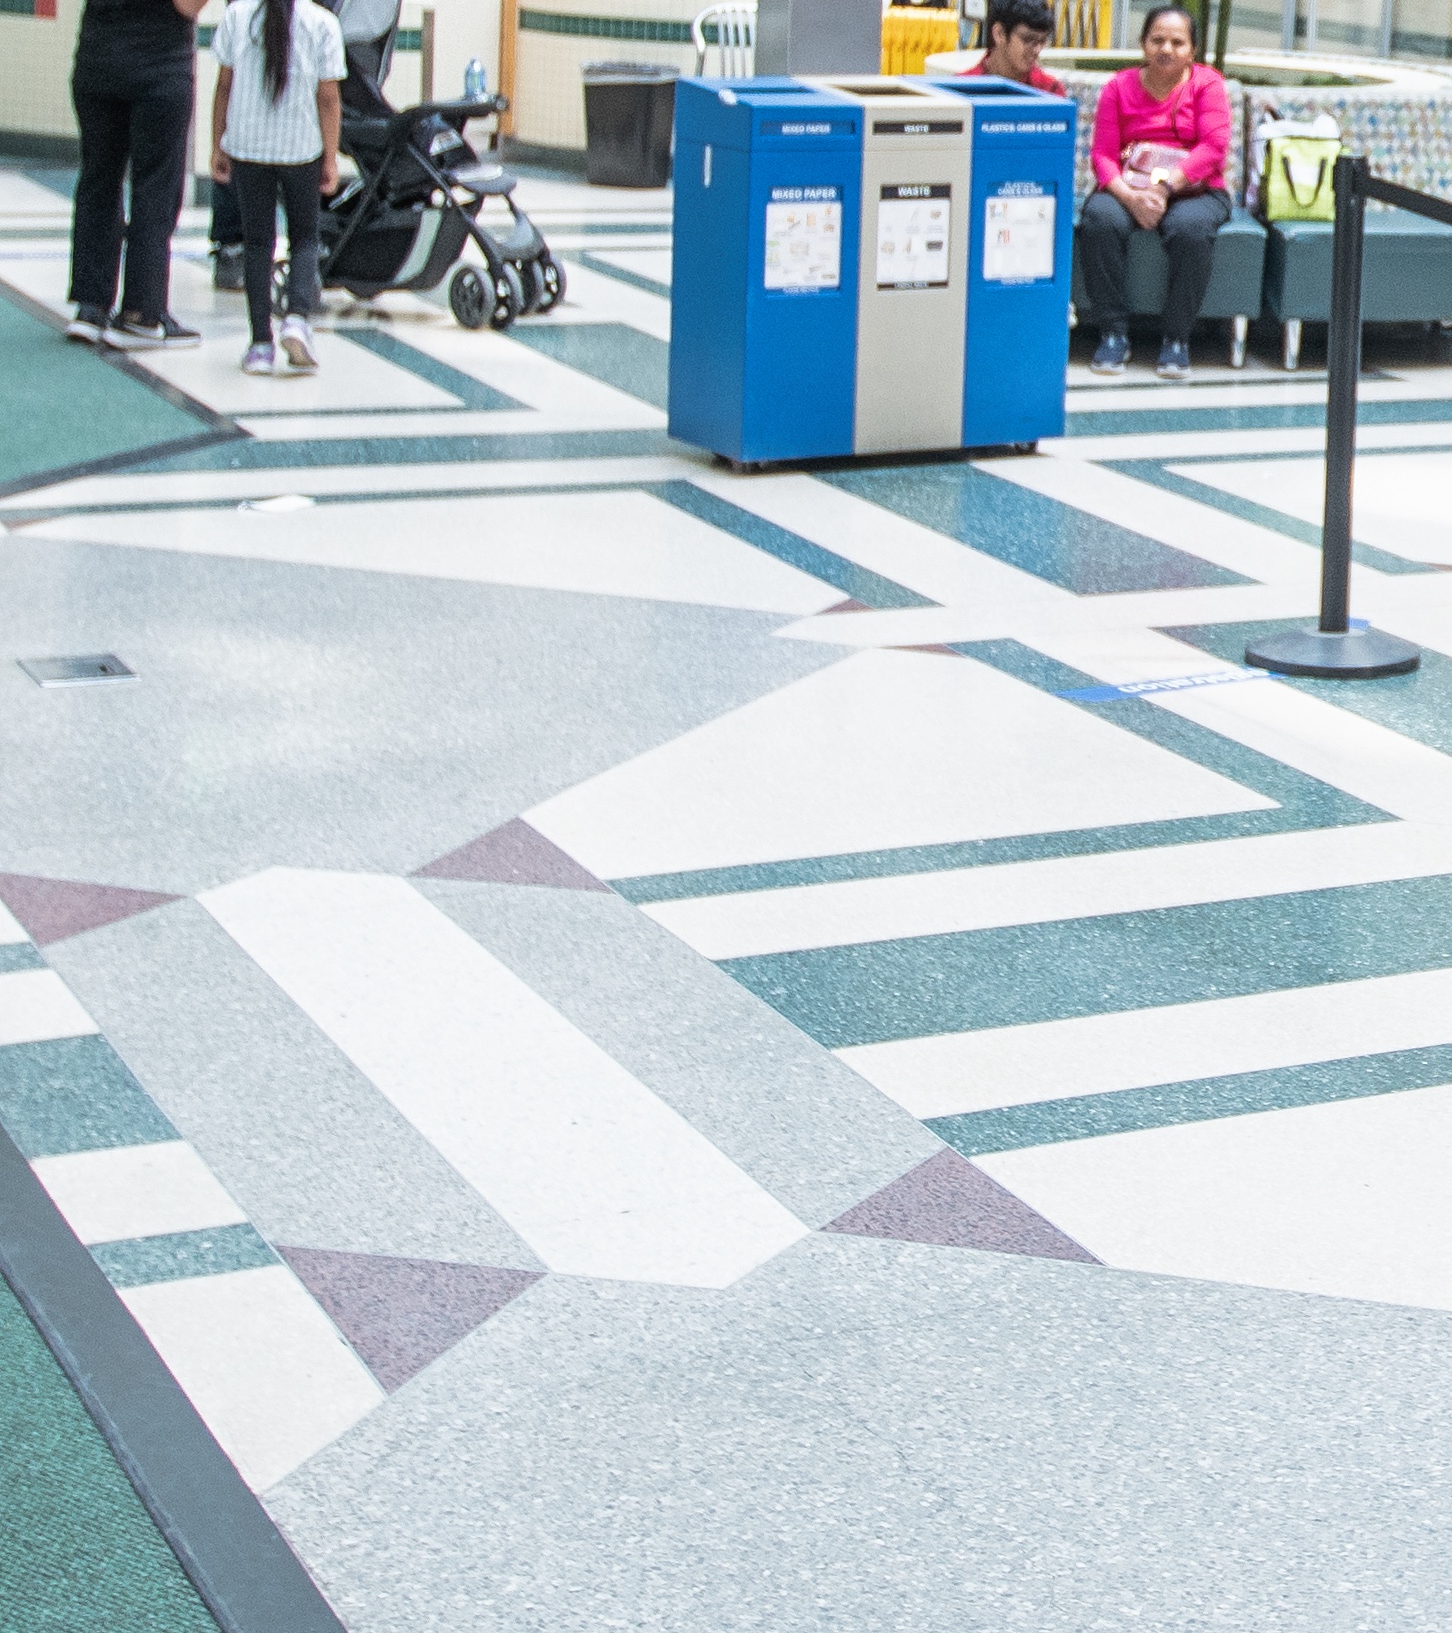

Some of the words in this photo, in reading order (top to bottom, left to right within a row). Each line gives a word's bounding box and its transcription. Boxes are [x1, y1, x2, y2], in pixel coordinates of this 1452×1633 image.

[806, 123, 831, 134] PAPER
[904, 124, 929, 133] WASTE
[771, 187, 802, 199] MIXED
[804, 186, 837, 198] PAPER
[898, 187, 931, 196] WASTE
